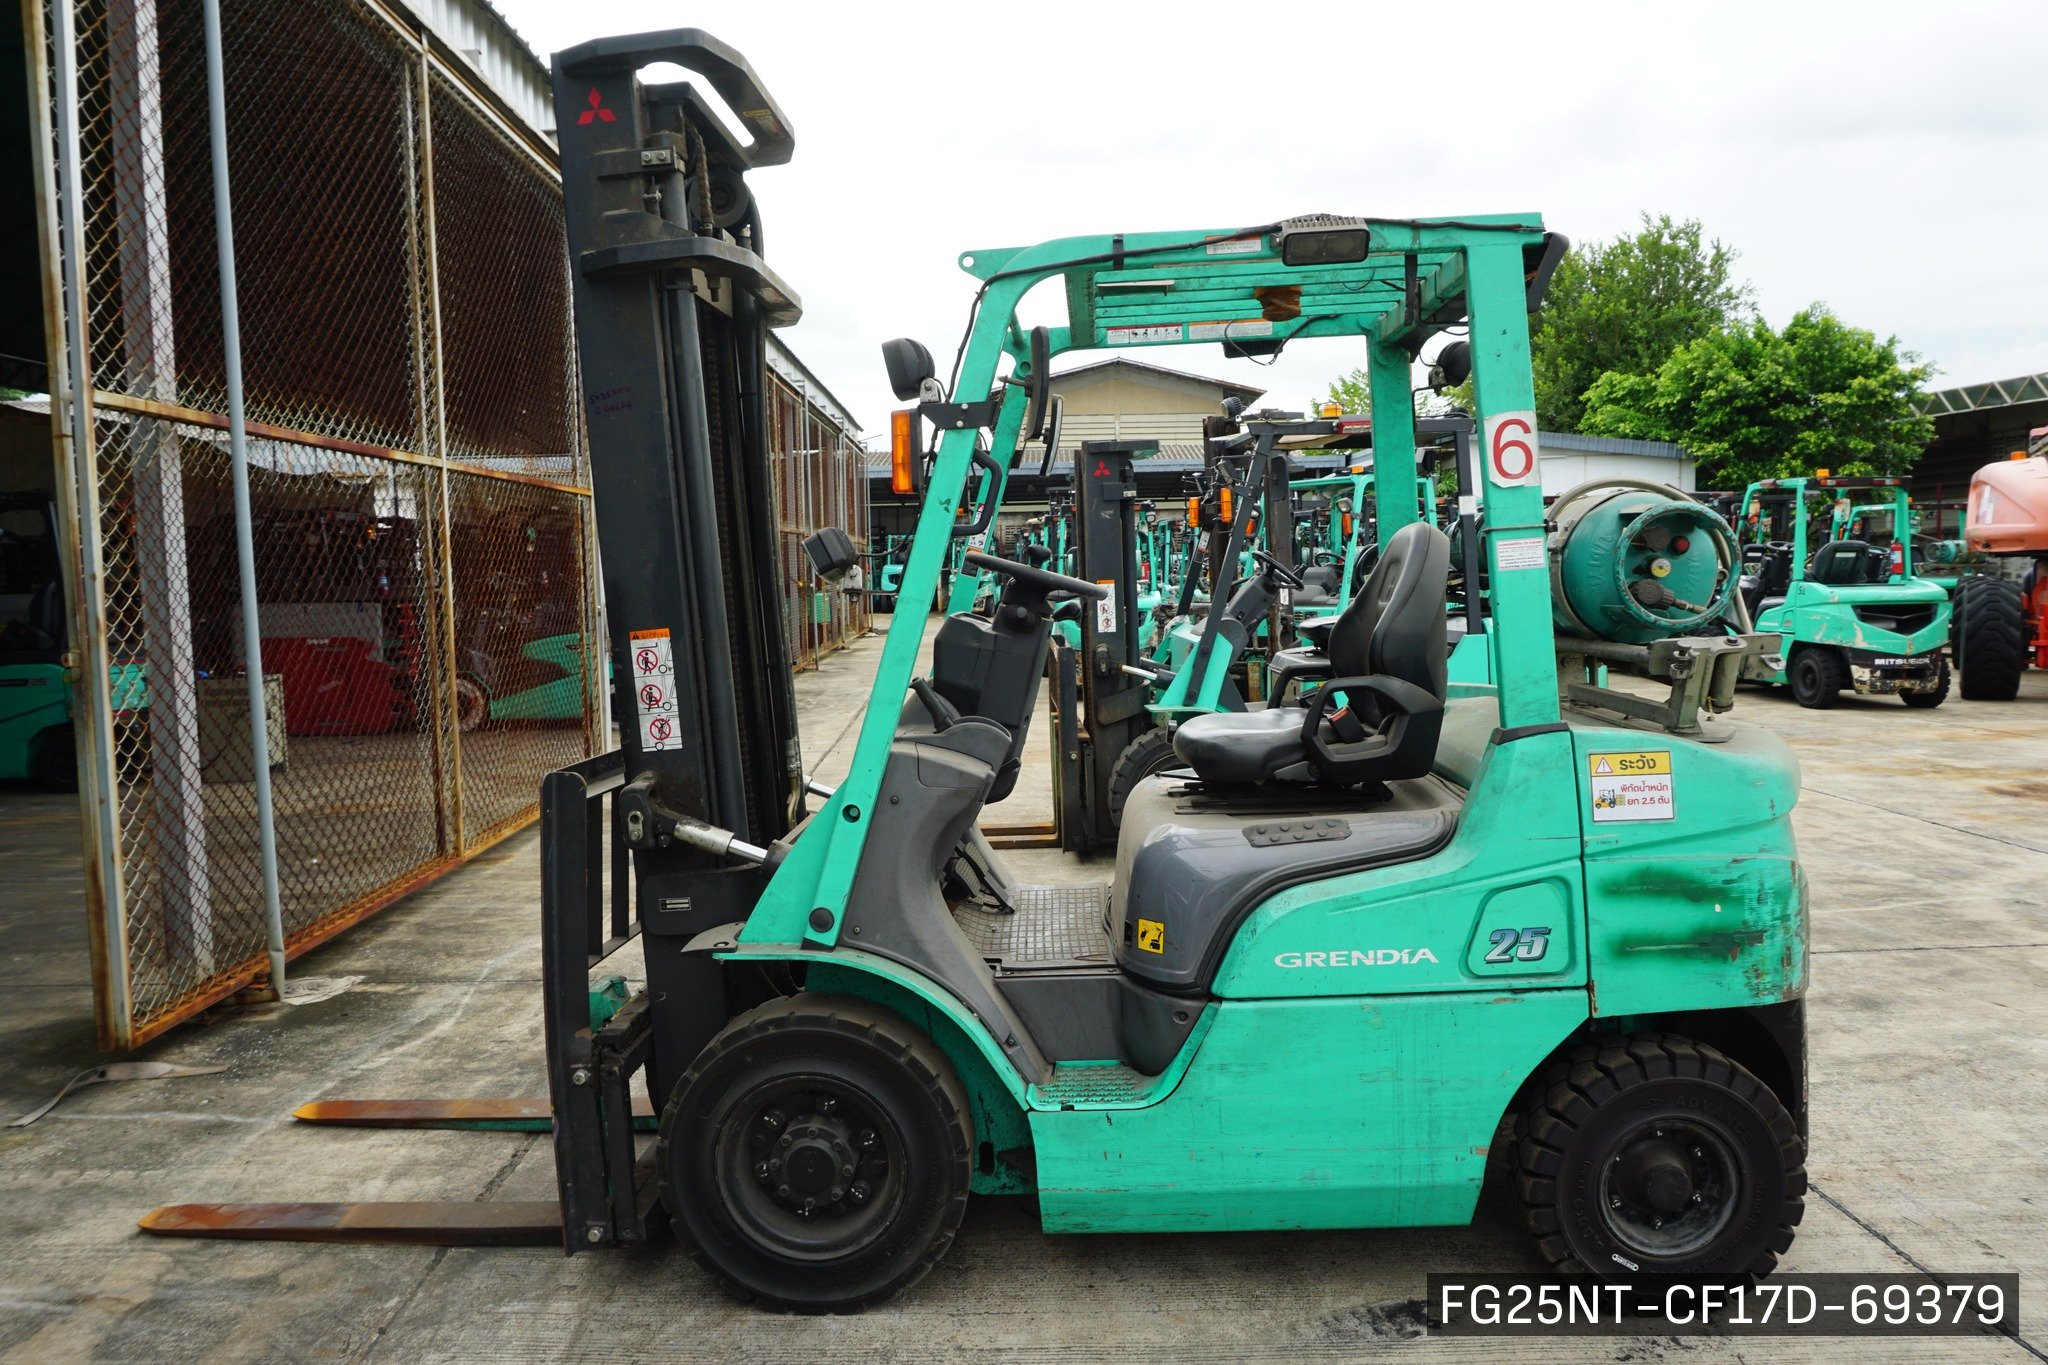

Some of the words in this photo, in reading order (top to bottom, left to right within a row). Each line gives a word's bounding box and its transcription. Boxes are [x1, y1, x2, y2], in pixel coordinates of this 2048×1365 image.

[1493, 418, 1534, 480] 6
[1619, 755, 1657, 771] ระวัง
[1620, 780, 1669, 793] พิกัดน้ำหนัก
[1627, 798, 1639, 806] ยก
[1641, 797, 1656, 805] 2.5
[1657, 796, 1670, 805] ตัน
[1484, 927, 1552, 964] 25
[1273, 948, 1440, 968] GRENDIA
